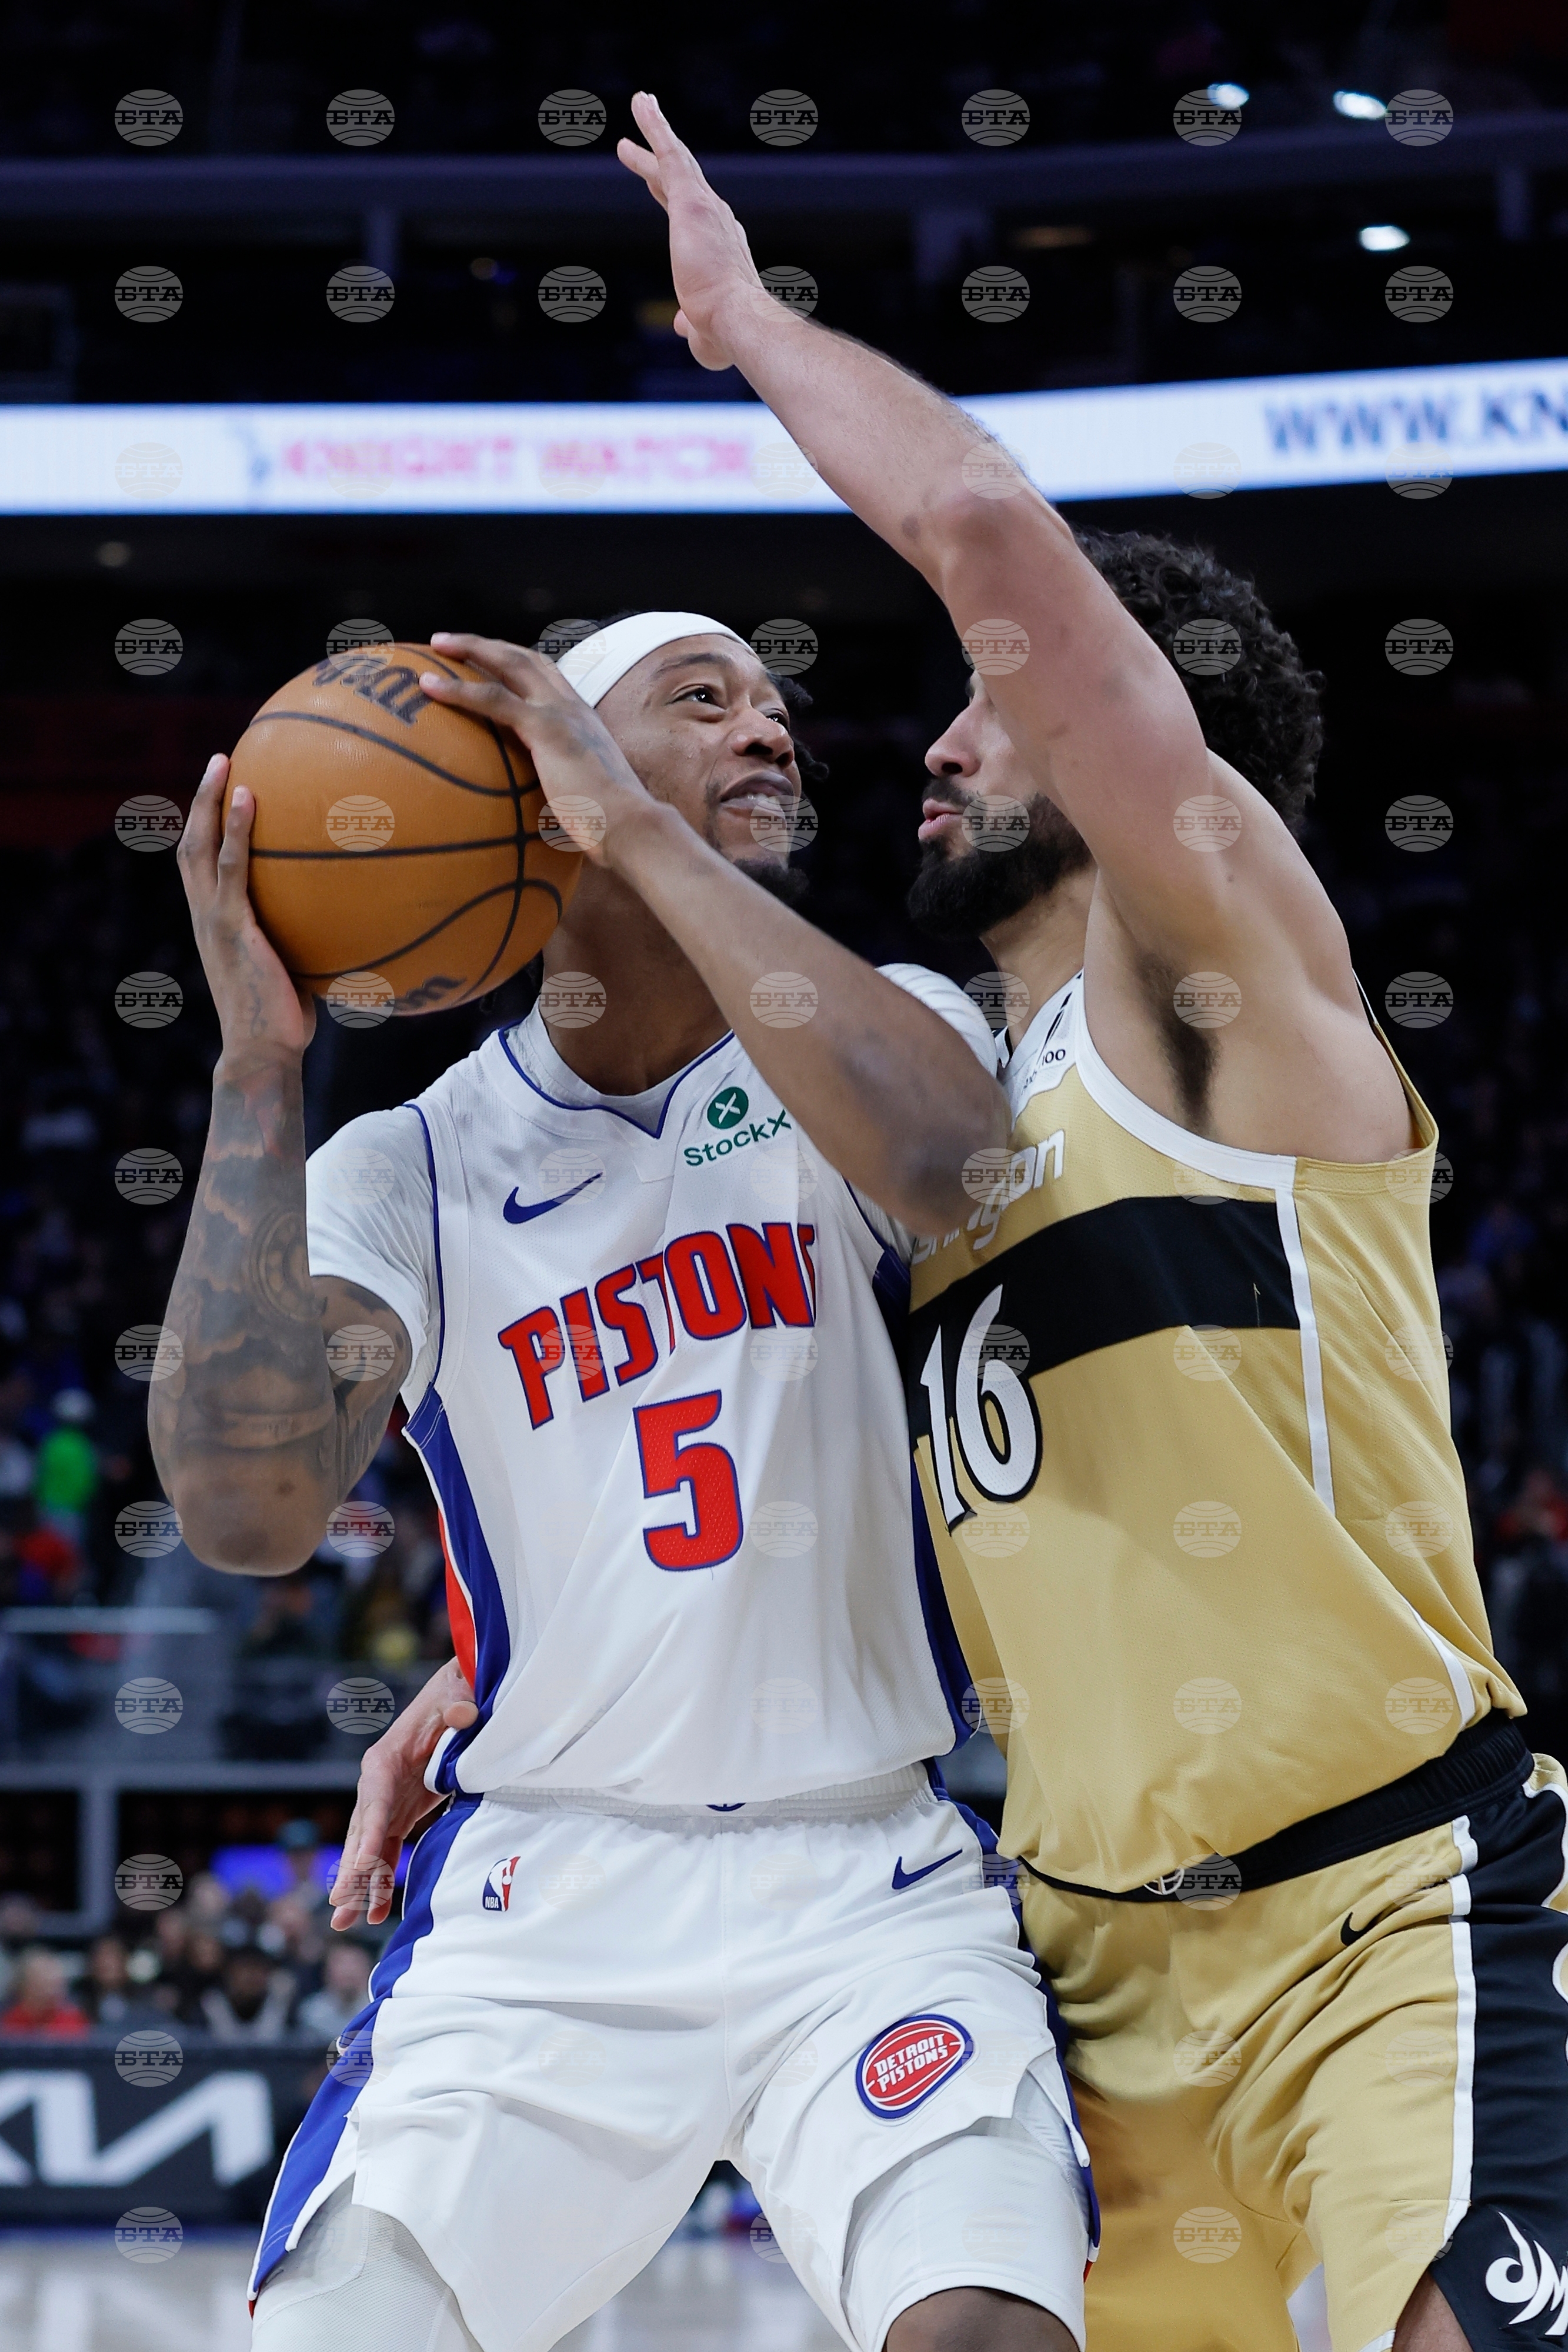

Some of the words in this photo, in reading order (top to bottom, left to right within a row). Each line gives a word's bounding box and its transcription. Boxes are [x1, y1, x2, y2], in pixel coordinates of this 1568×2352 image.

[683, 1109, 792, 1166] StockX
[919, 1283, 1043, 1537] 16
[632, 1388, 744, 1572] 5
[485, 1896, 499, 1909] NBA
[873, 2033, 945, 2077] DETROIT
[876, 2044, 948, 2093] PISTONS
